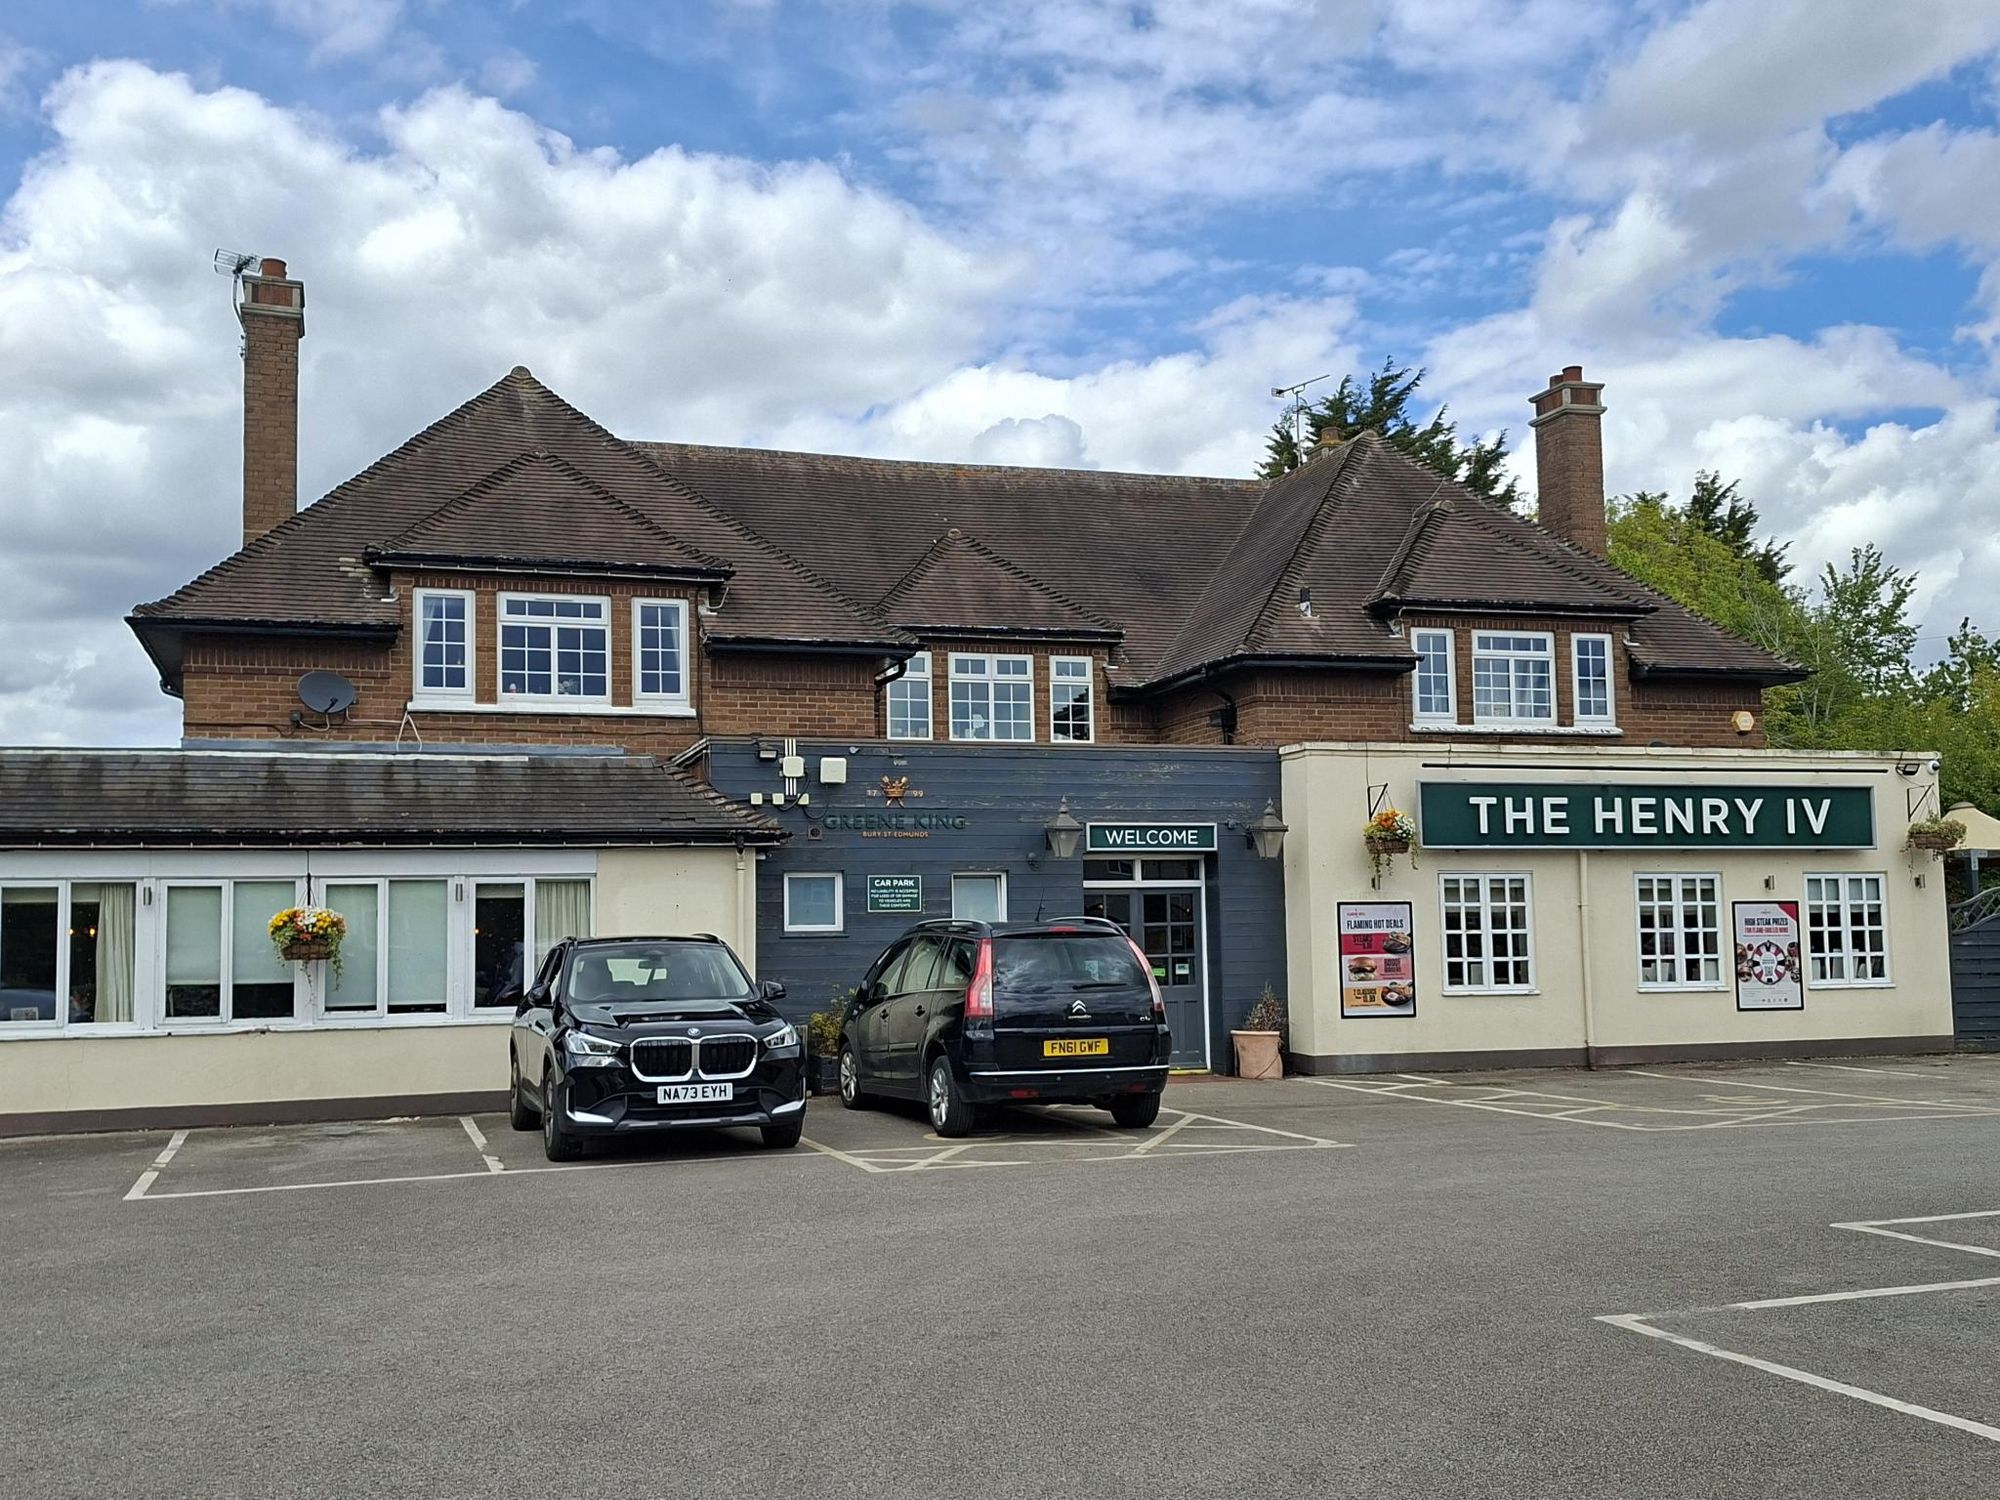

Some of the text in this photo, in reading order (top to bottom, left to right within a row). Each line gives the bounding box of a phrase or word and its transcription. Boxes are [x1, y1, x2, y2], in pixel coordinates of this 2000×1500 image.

[823, 814, 966, 830] GREENE KING
[1469, 797, 1831, 835] THE HENRY IV
[1105, 830, 1199, 845] WELCOME
[874, 879, 915, 887] CAR PARK
[1347, 919, 1404, 930] FLAMING HOT DEALS
[1051, 1041, 1101, 1053] FN61 GWF
[663, 1085, 727, 1101] NA73 EYH
